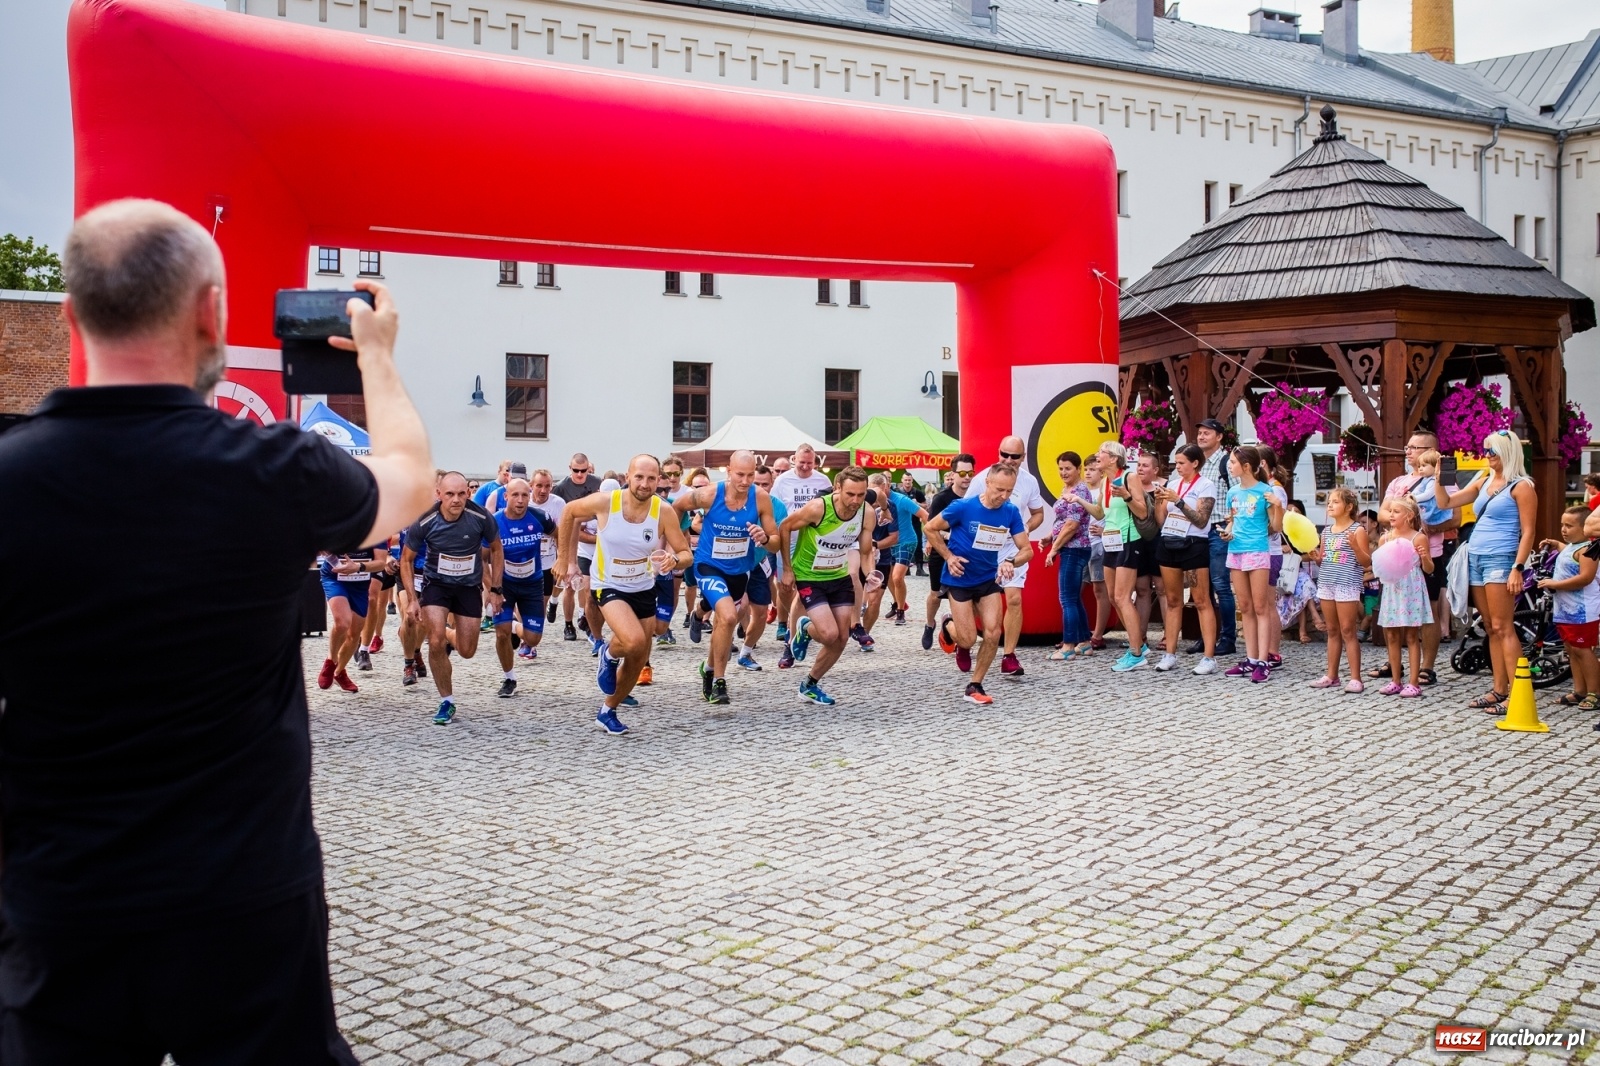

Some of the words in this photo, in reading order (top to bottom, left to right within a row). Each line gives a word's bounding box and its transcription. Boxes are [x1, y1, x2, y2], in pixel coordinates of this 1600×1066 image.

[941, 346, 952, 360] B
[872, 453, 921, 466] SORBETY
[712, 522, 749, 532] WODZISŁA
[987, 533, 997, 542] 36
[625, 567, 636, 575] 39
